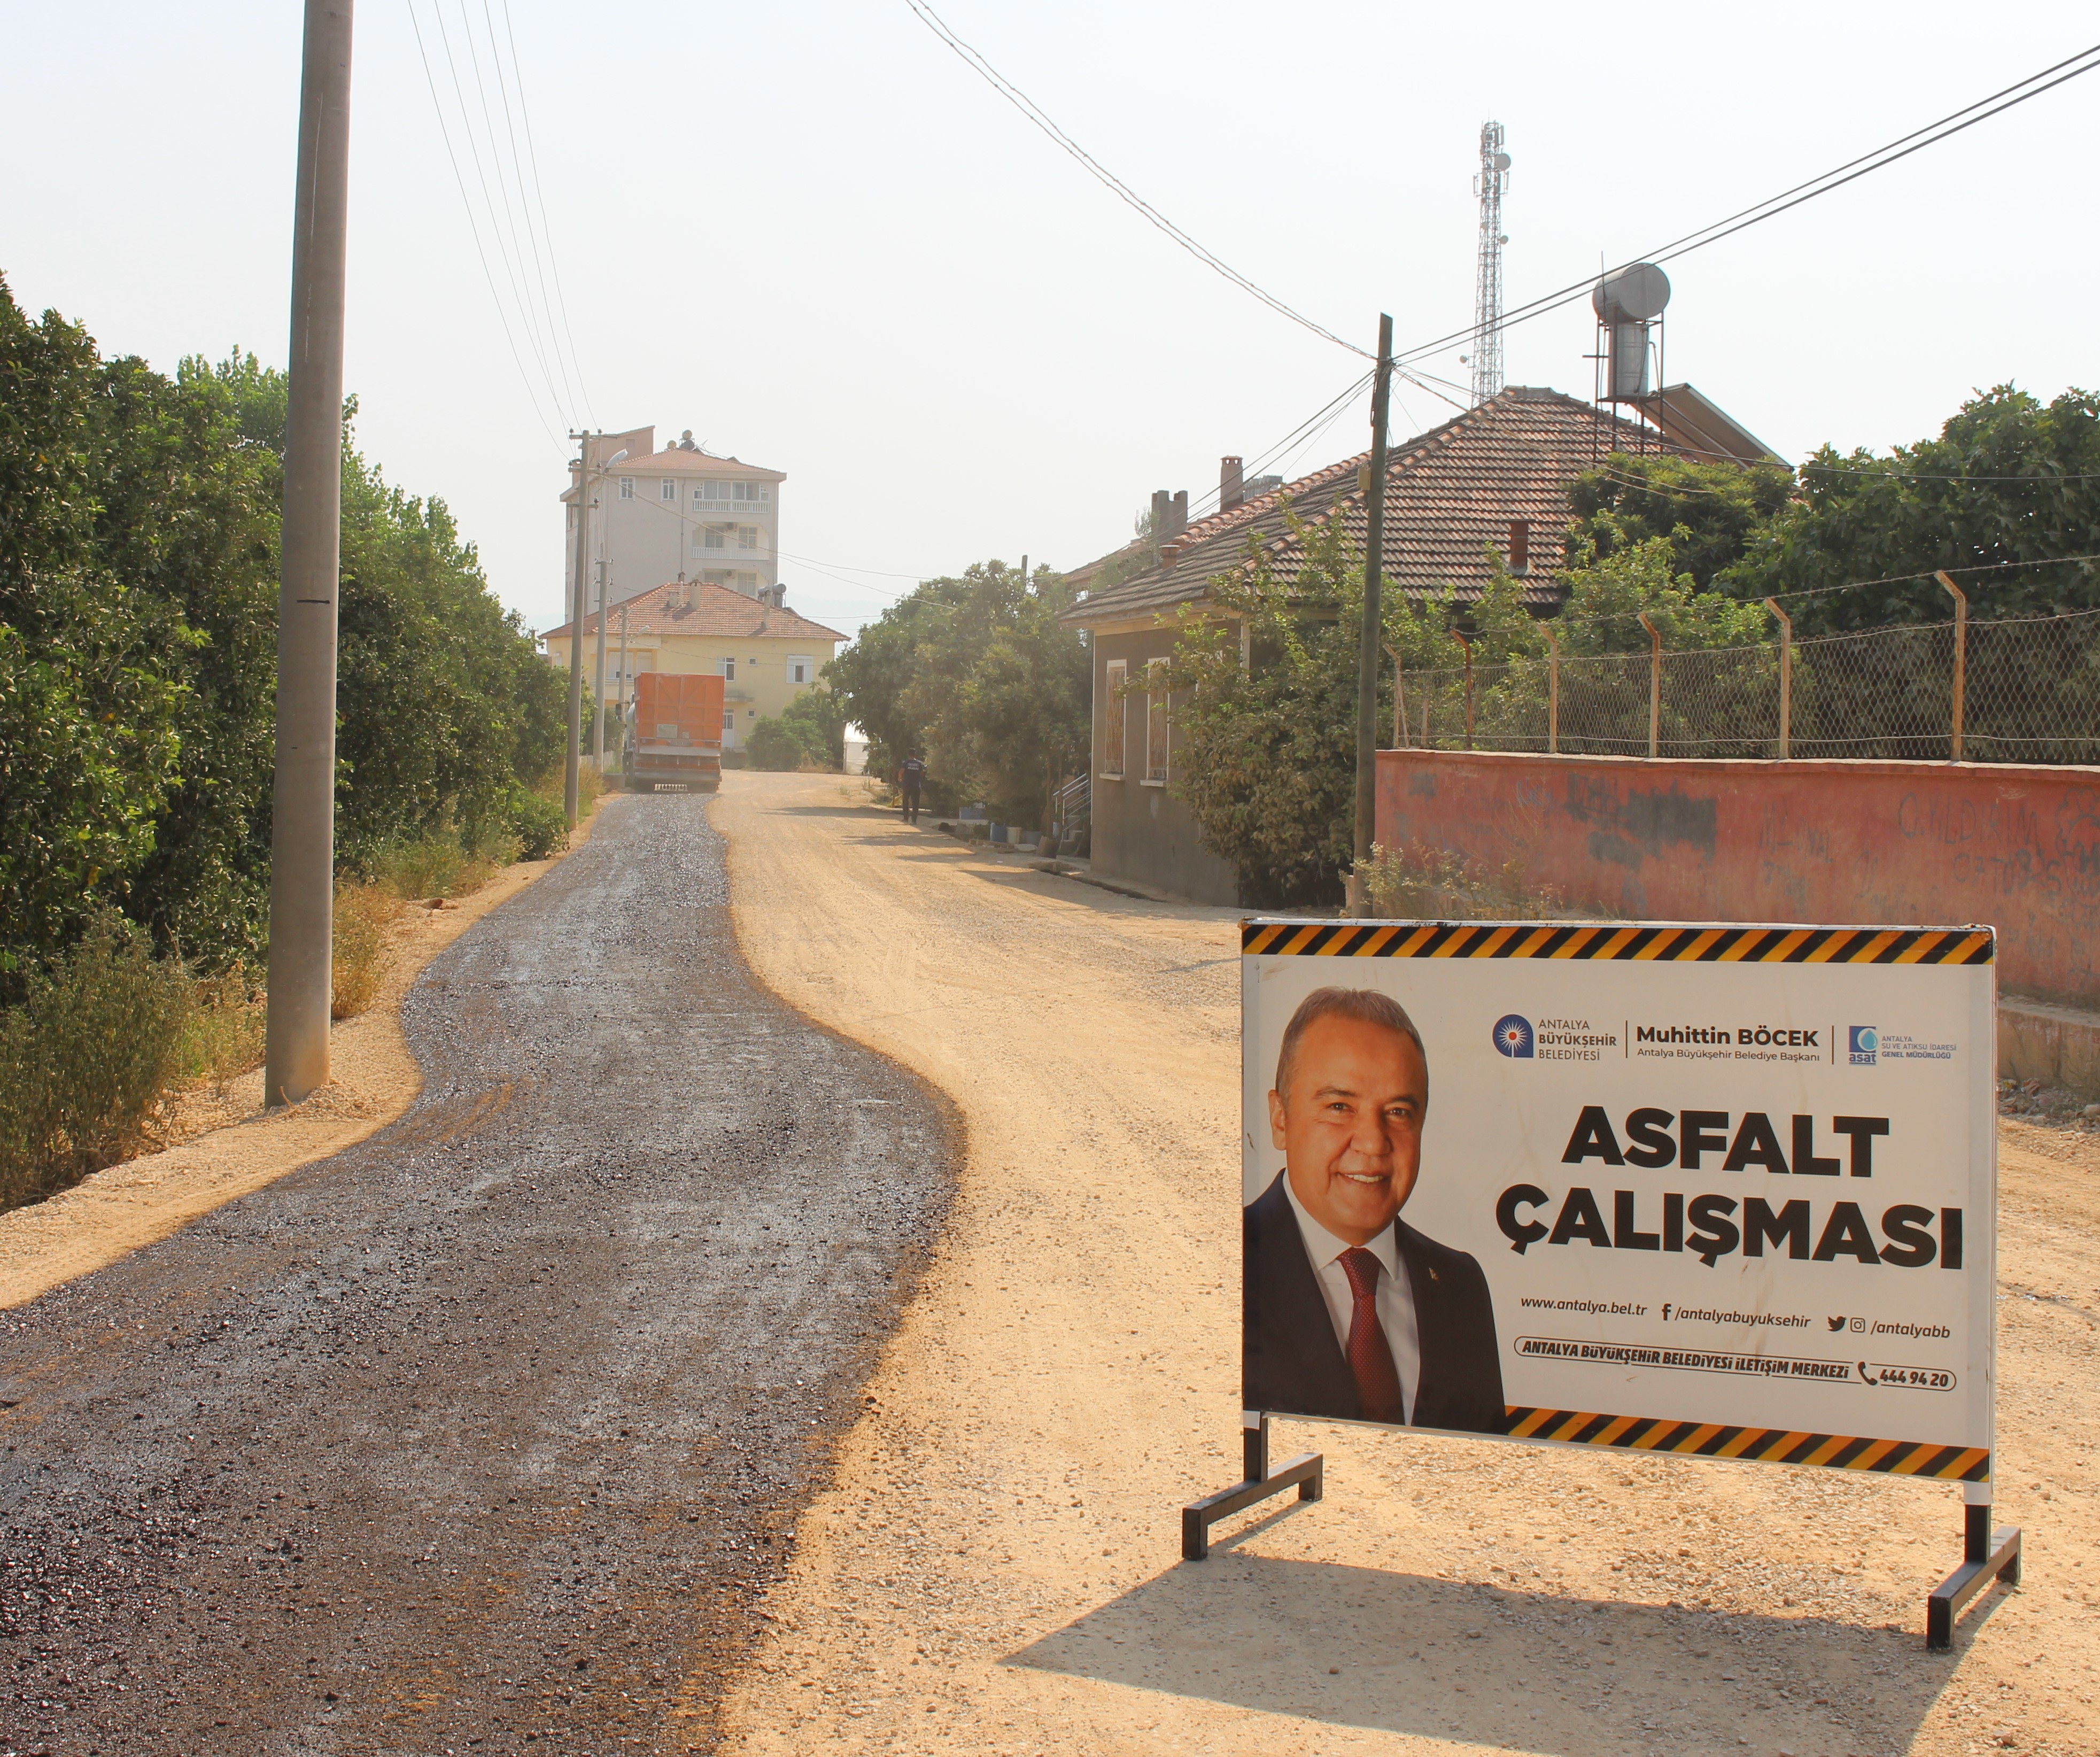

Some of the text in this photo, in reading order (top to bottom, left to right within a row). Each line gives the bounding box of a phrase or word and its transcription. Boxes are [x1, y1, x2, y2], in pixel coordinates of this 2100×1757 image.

[1538, 1019, 1590, 1030] ANTALYA
[1538, 1032, 1617, 1048] BÜYÜKŞEHİR
[1637, 1025, 1819, 1047] Muhittin BÖCEK
[1539, 1048, 1600, 1061] BELEDİYESİ
[1906, 1051, 1951, 1059] MÜDÜRLÜĞÜ
[1929, 1043, 1956, 1051] İDARESİ
[1637, 1048, 1820, 1063] Antalya Büyükşehir Belediye Başkanı
[1849, 1053, 1876, 1063] asat
[1561, 1105, 1889, 1178] ASFALT
[1495, 1183, 1963, 1270] ÇALIŞMASI
[1521, 1298, 1647, 1315] www.antalya.bel.tr
[1675, 1306, 1811, 1328] /antalyabuyuksehir
[1870, 1320, 1950, 1338] /antalyabb
[1522, 1341, 1948, 1387] ANTALYA BÜYÜKŞEHİR BELEDİYESİ İLETİŞİM MERKEZİ 444 94 20
